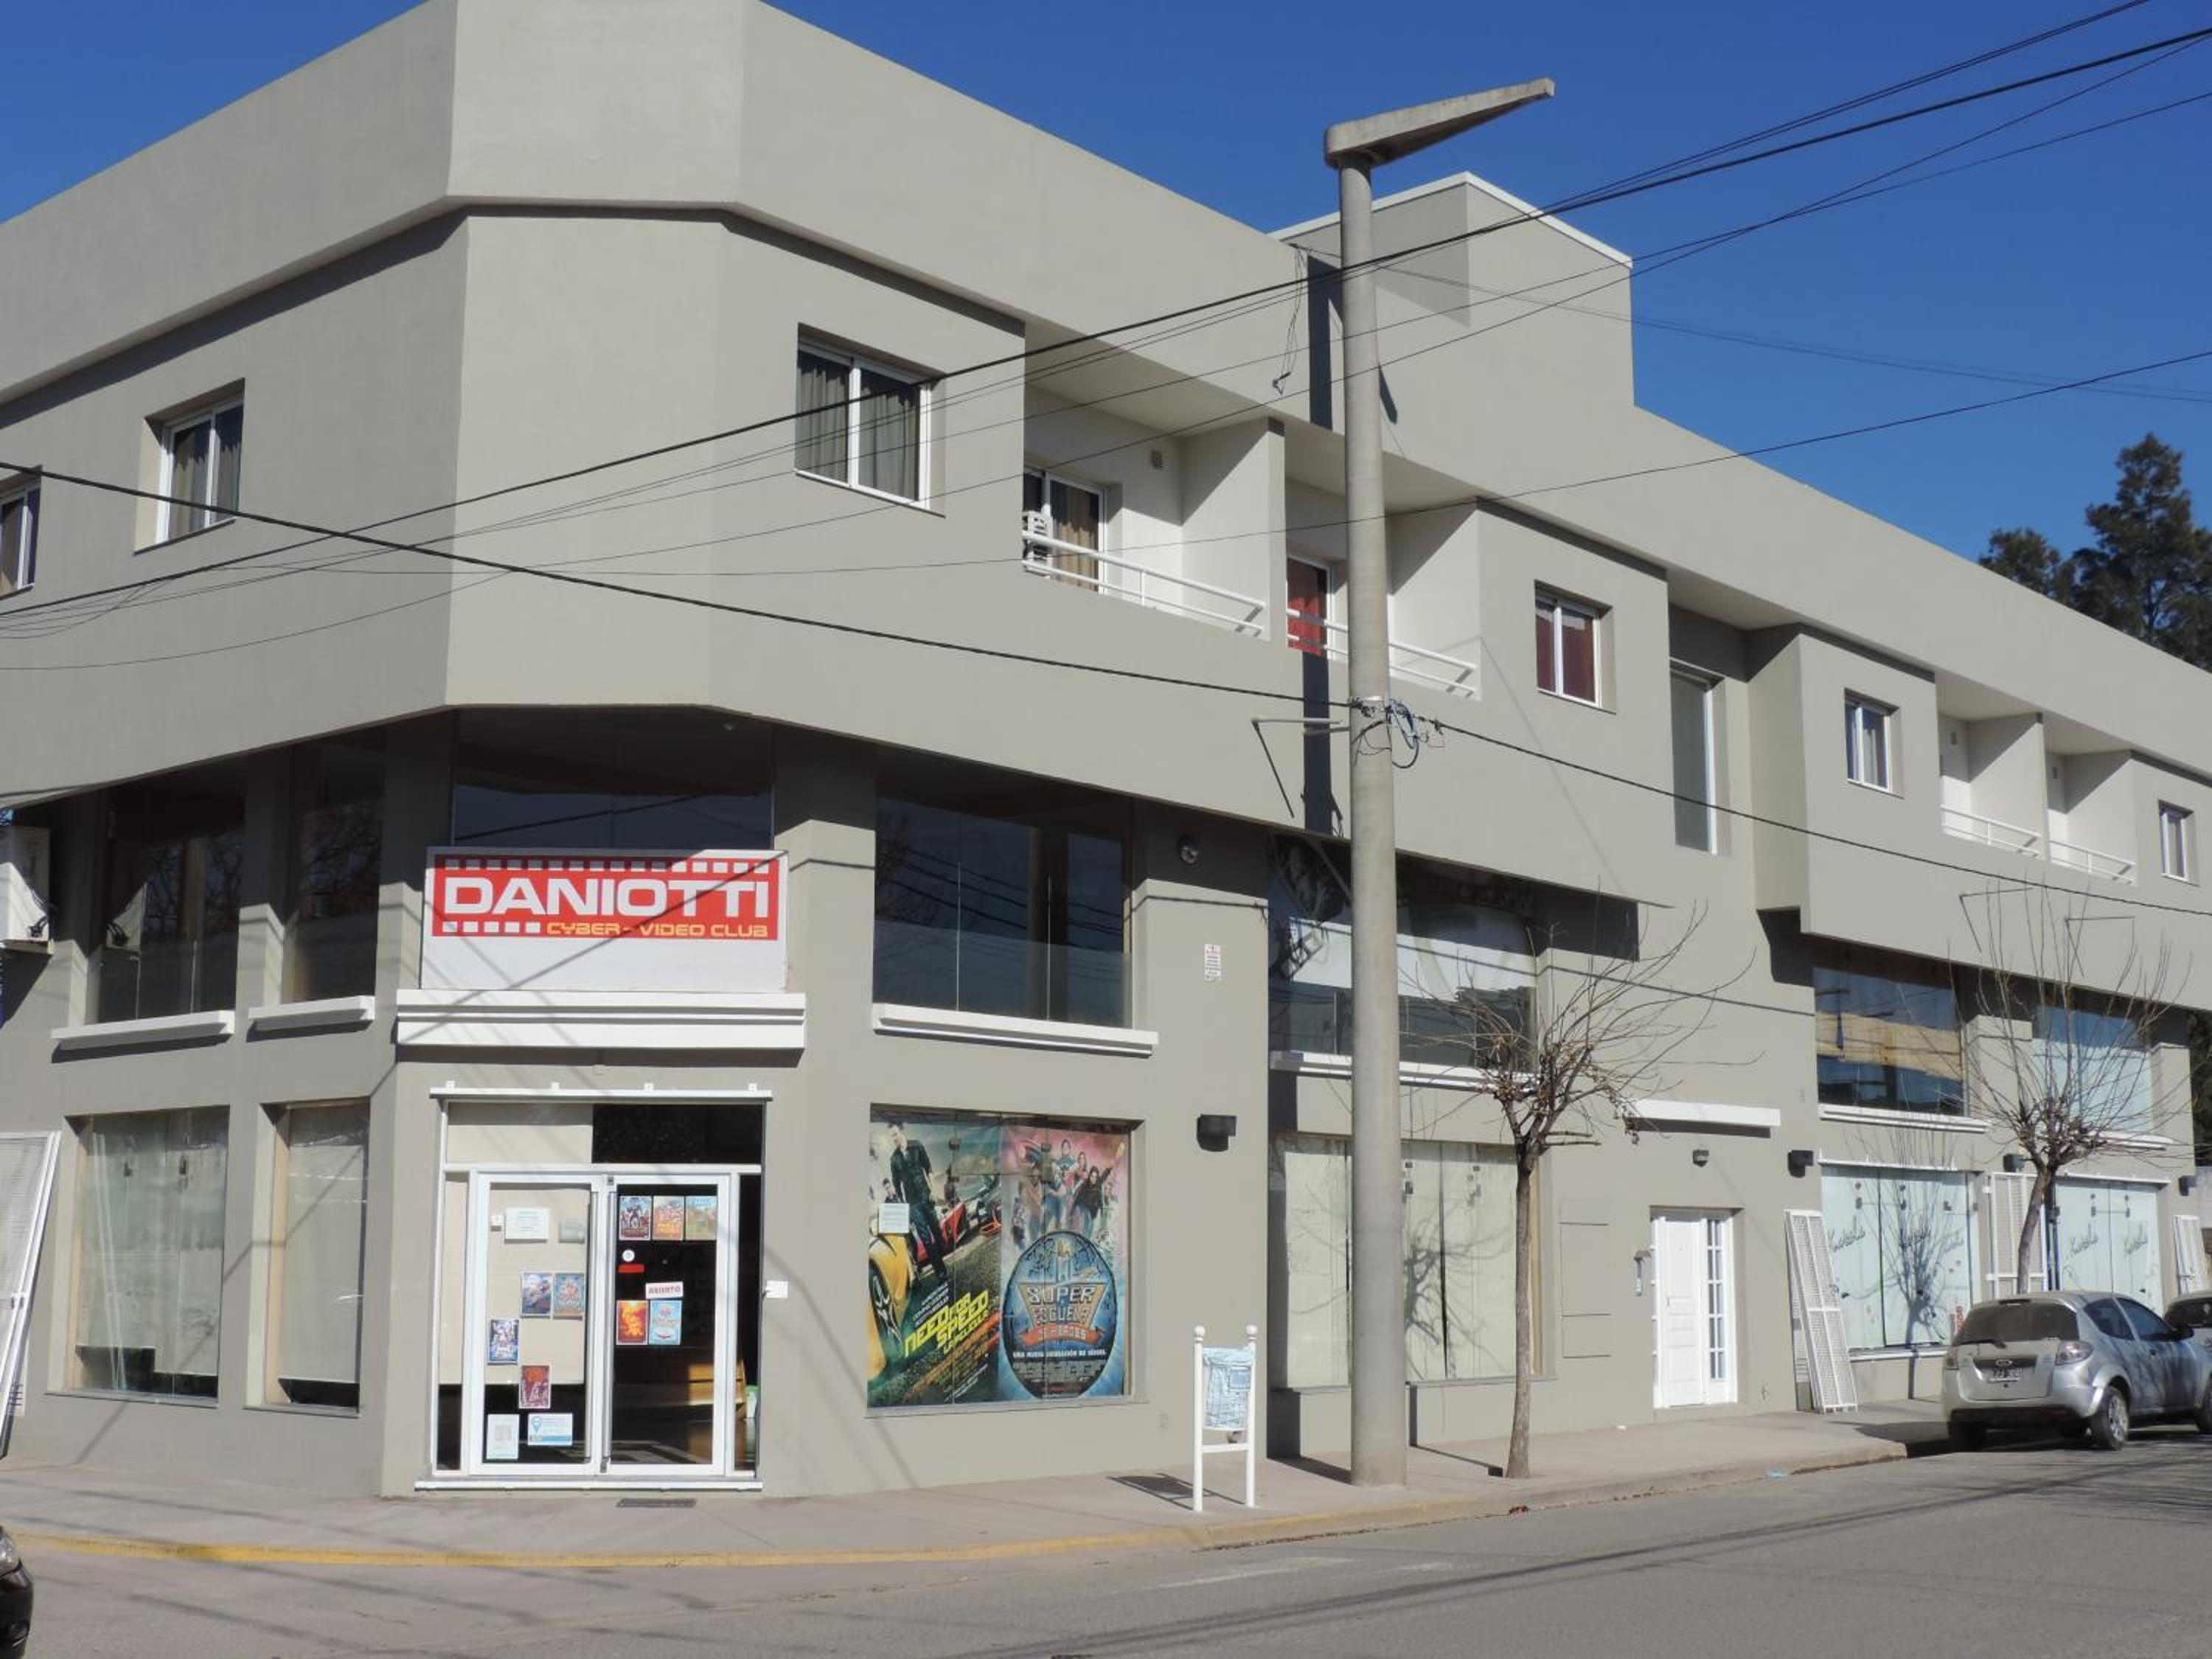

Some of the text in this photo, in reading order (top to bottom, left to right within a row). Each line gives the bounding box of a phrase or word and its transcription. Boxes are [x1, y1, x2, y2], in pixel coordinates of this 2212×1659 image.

[445, 877, 768, 918] DANIOTTI
[639, 924, 706, 936] VIDEO
[711, 925, 768, 937] CLUB
[1027, 1286, 1095, 1304] SUPER
[905, 1304, 949, 1357] NEED
[936, 1290, 989, 1349] SPEED
